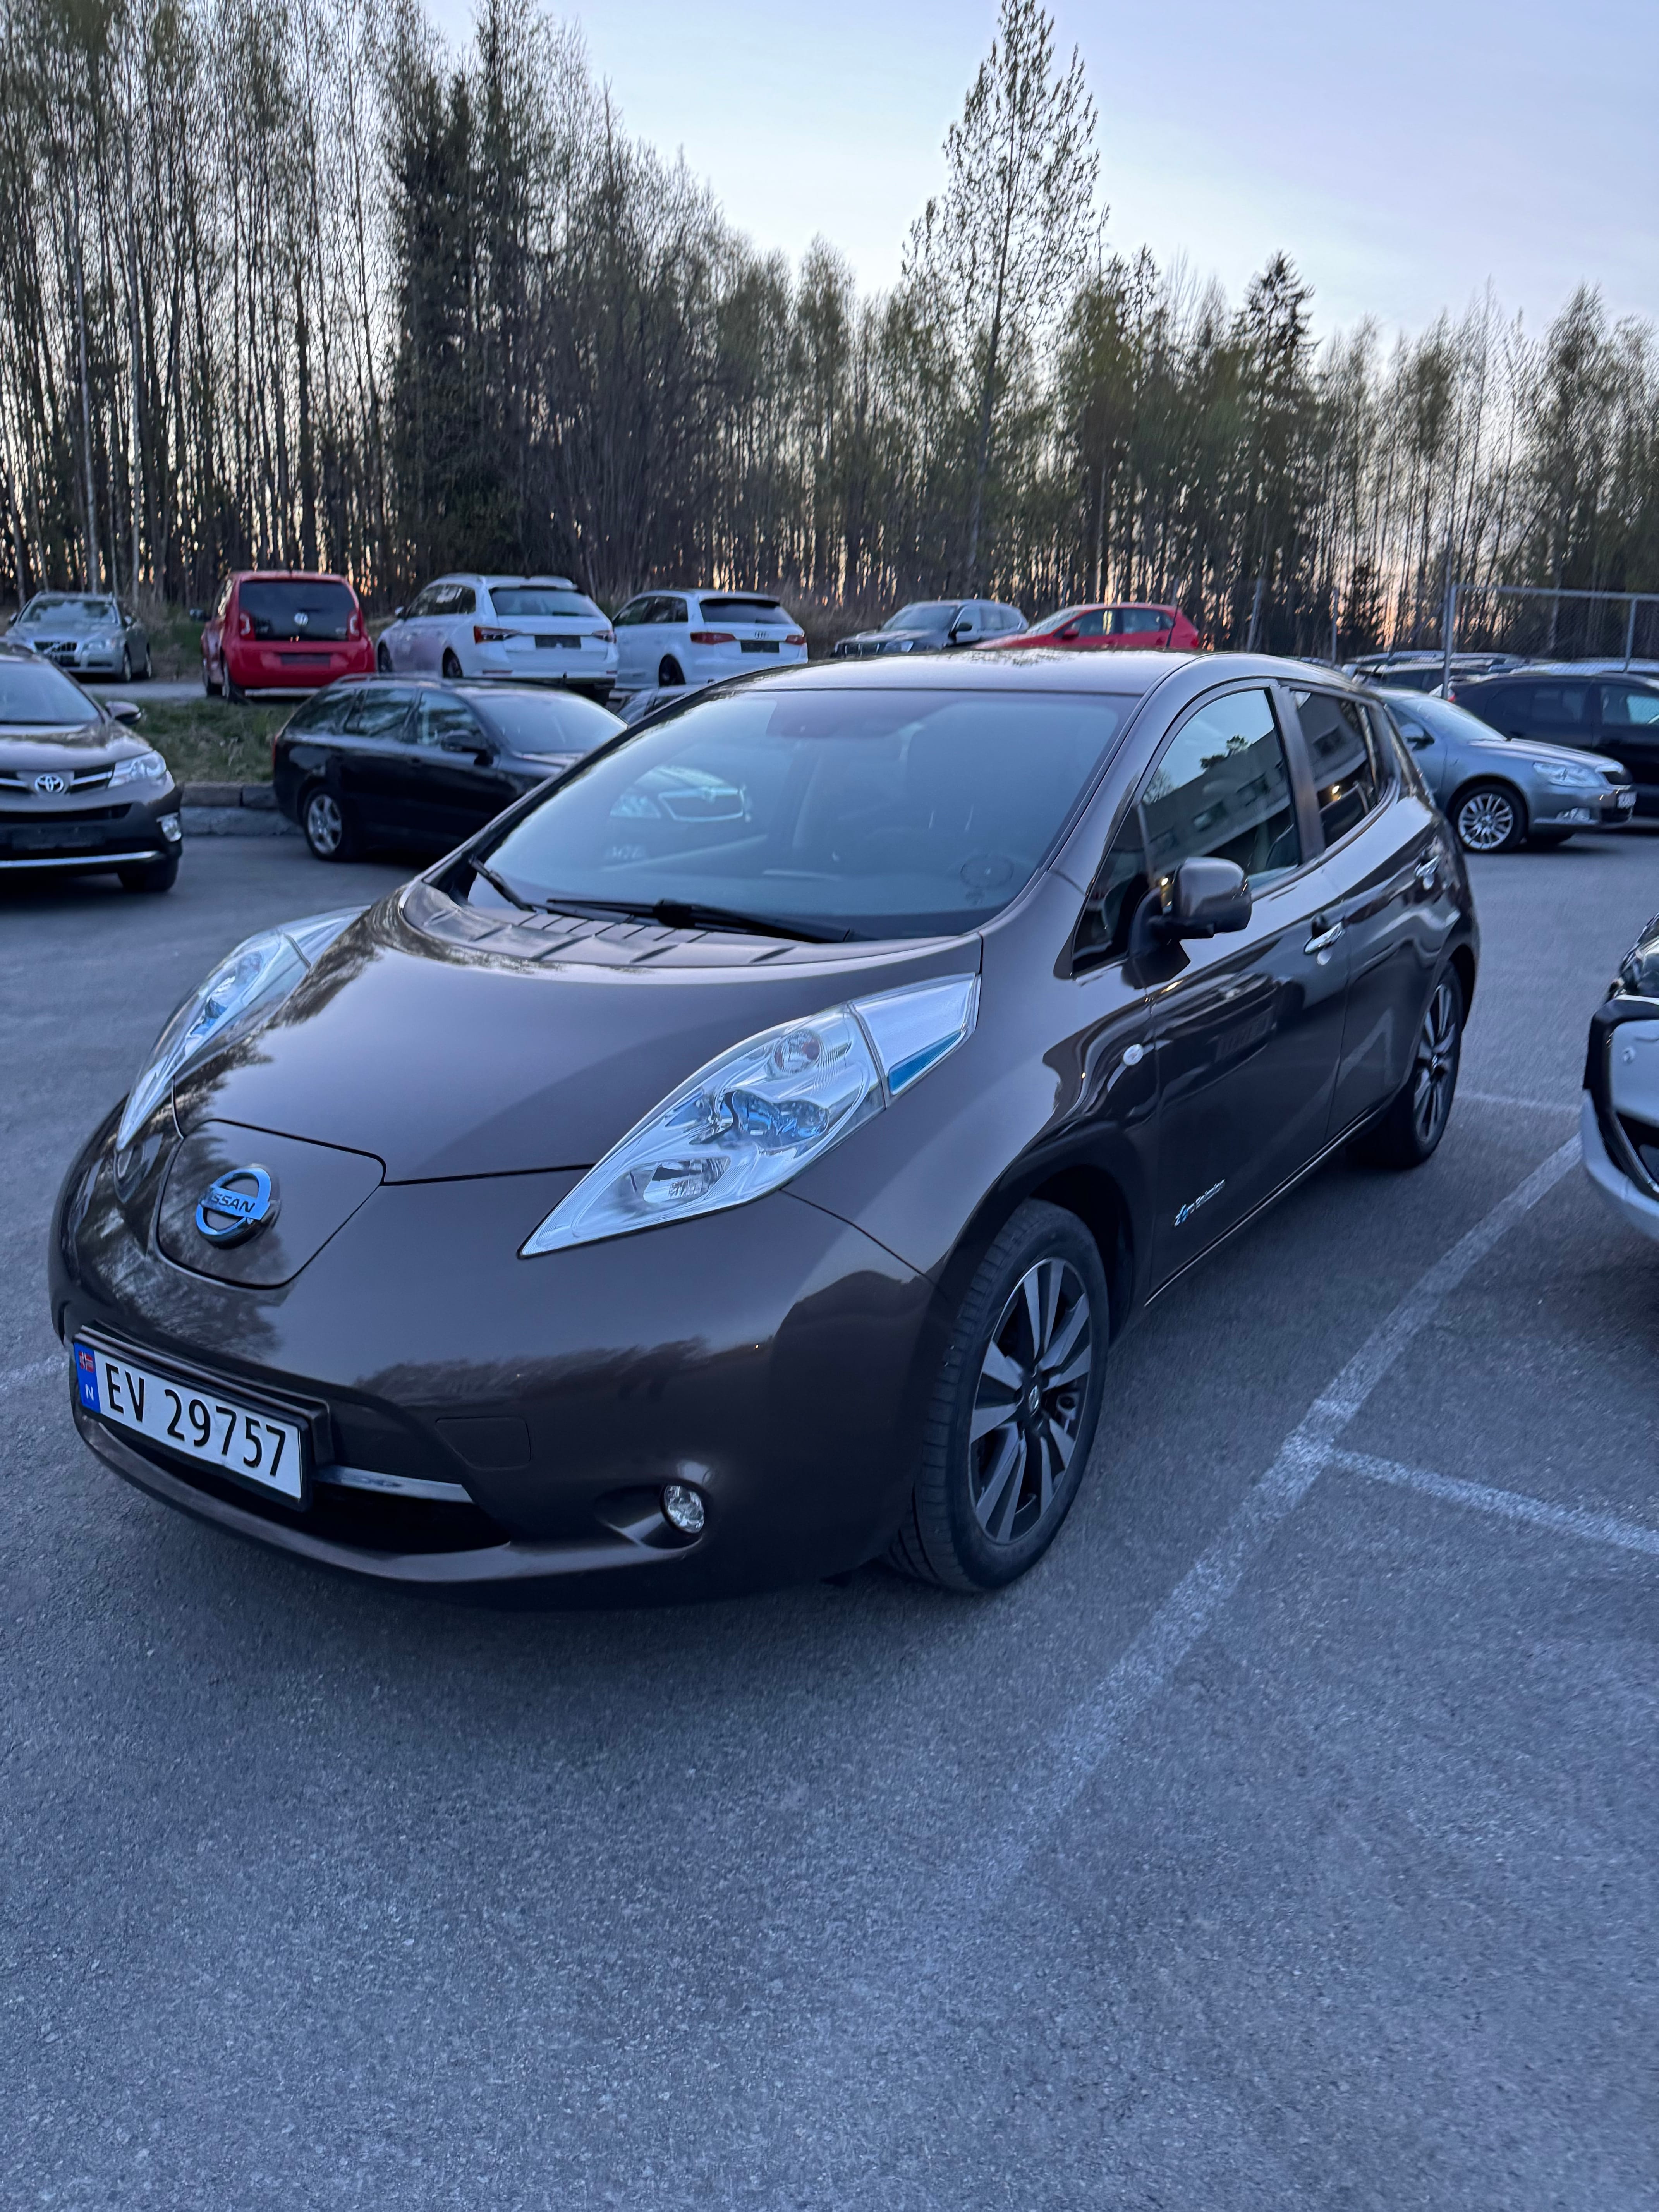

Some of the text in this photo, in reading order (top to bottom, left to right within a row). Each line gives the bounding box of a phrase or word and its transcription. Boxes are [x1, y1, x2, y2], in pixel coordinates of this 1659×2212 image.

[206, 1193, 256, 1213] SSAN
[85, 1384, 94, 1401] N
[105, 1363, 286, 1476] EV 29757
